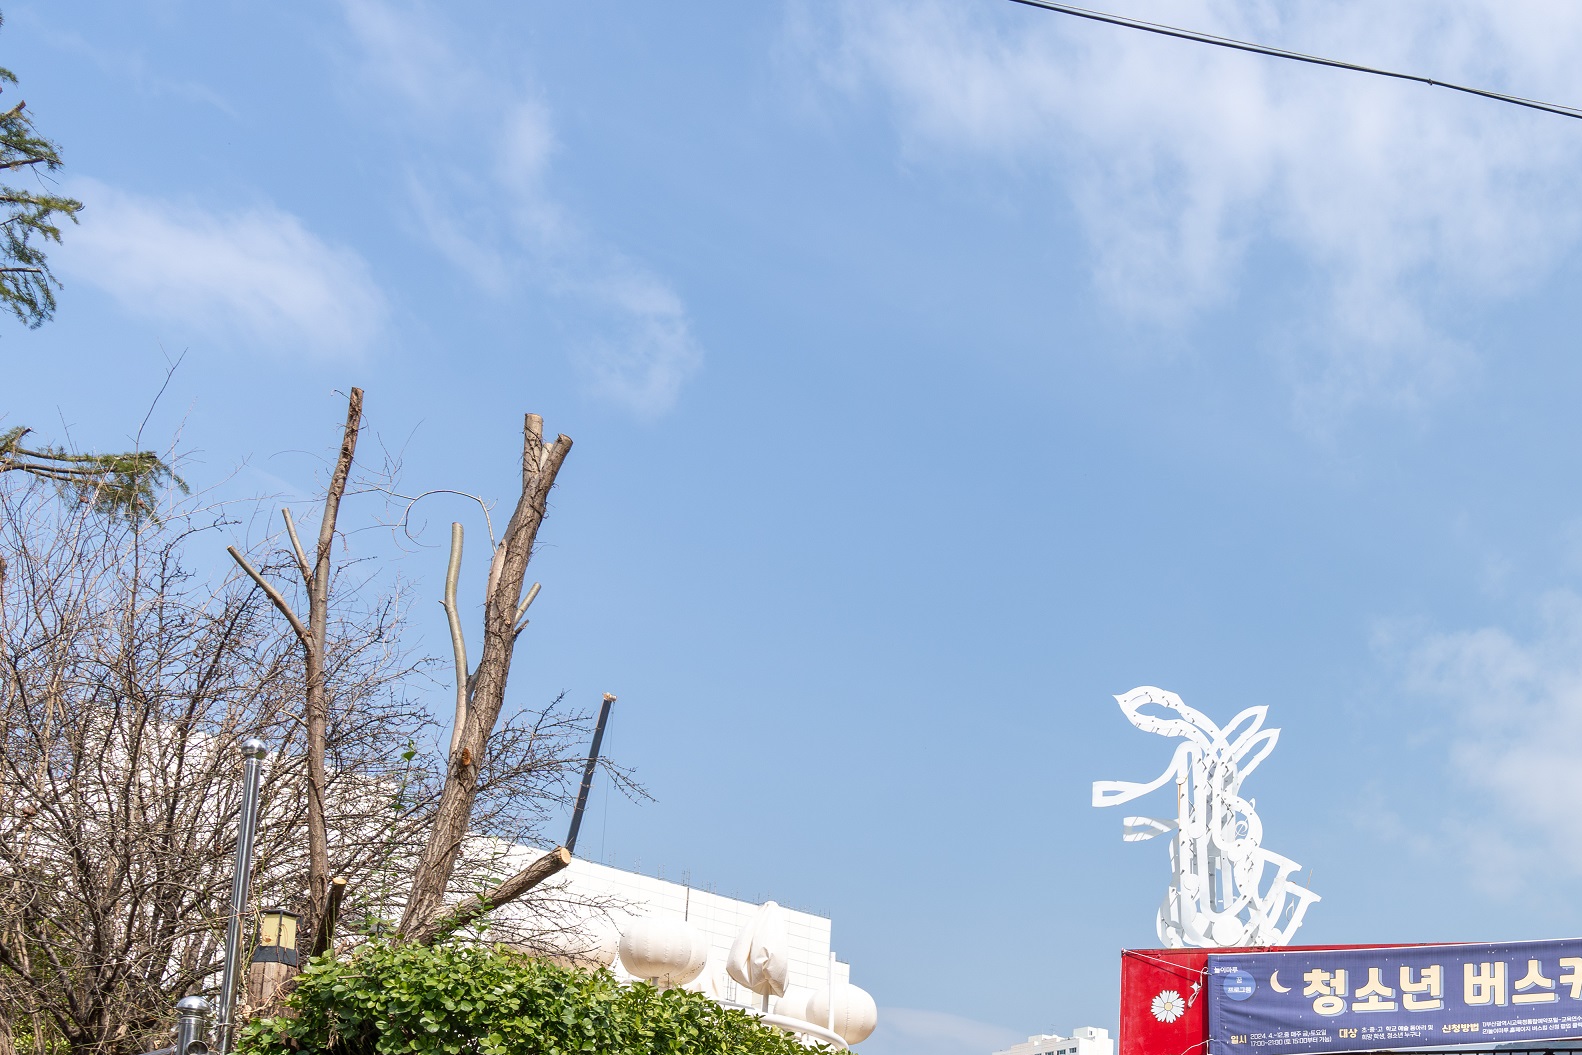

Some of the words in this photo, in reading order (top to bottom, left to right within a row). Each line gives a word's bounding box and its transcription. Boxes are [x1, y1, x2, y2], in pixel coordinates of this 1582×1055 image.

[1303, 966, 1444, 1016] 청소년
[1338, 1027, 1358, 1039] 대상
[1441, 1022, 1480, 1034] 신청방법
[1230, 1035, 1247, 1045] 일시
